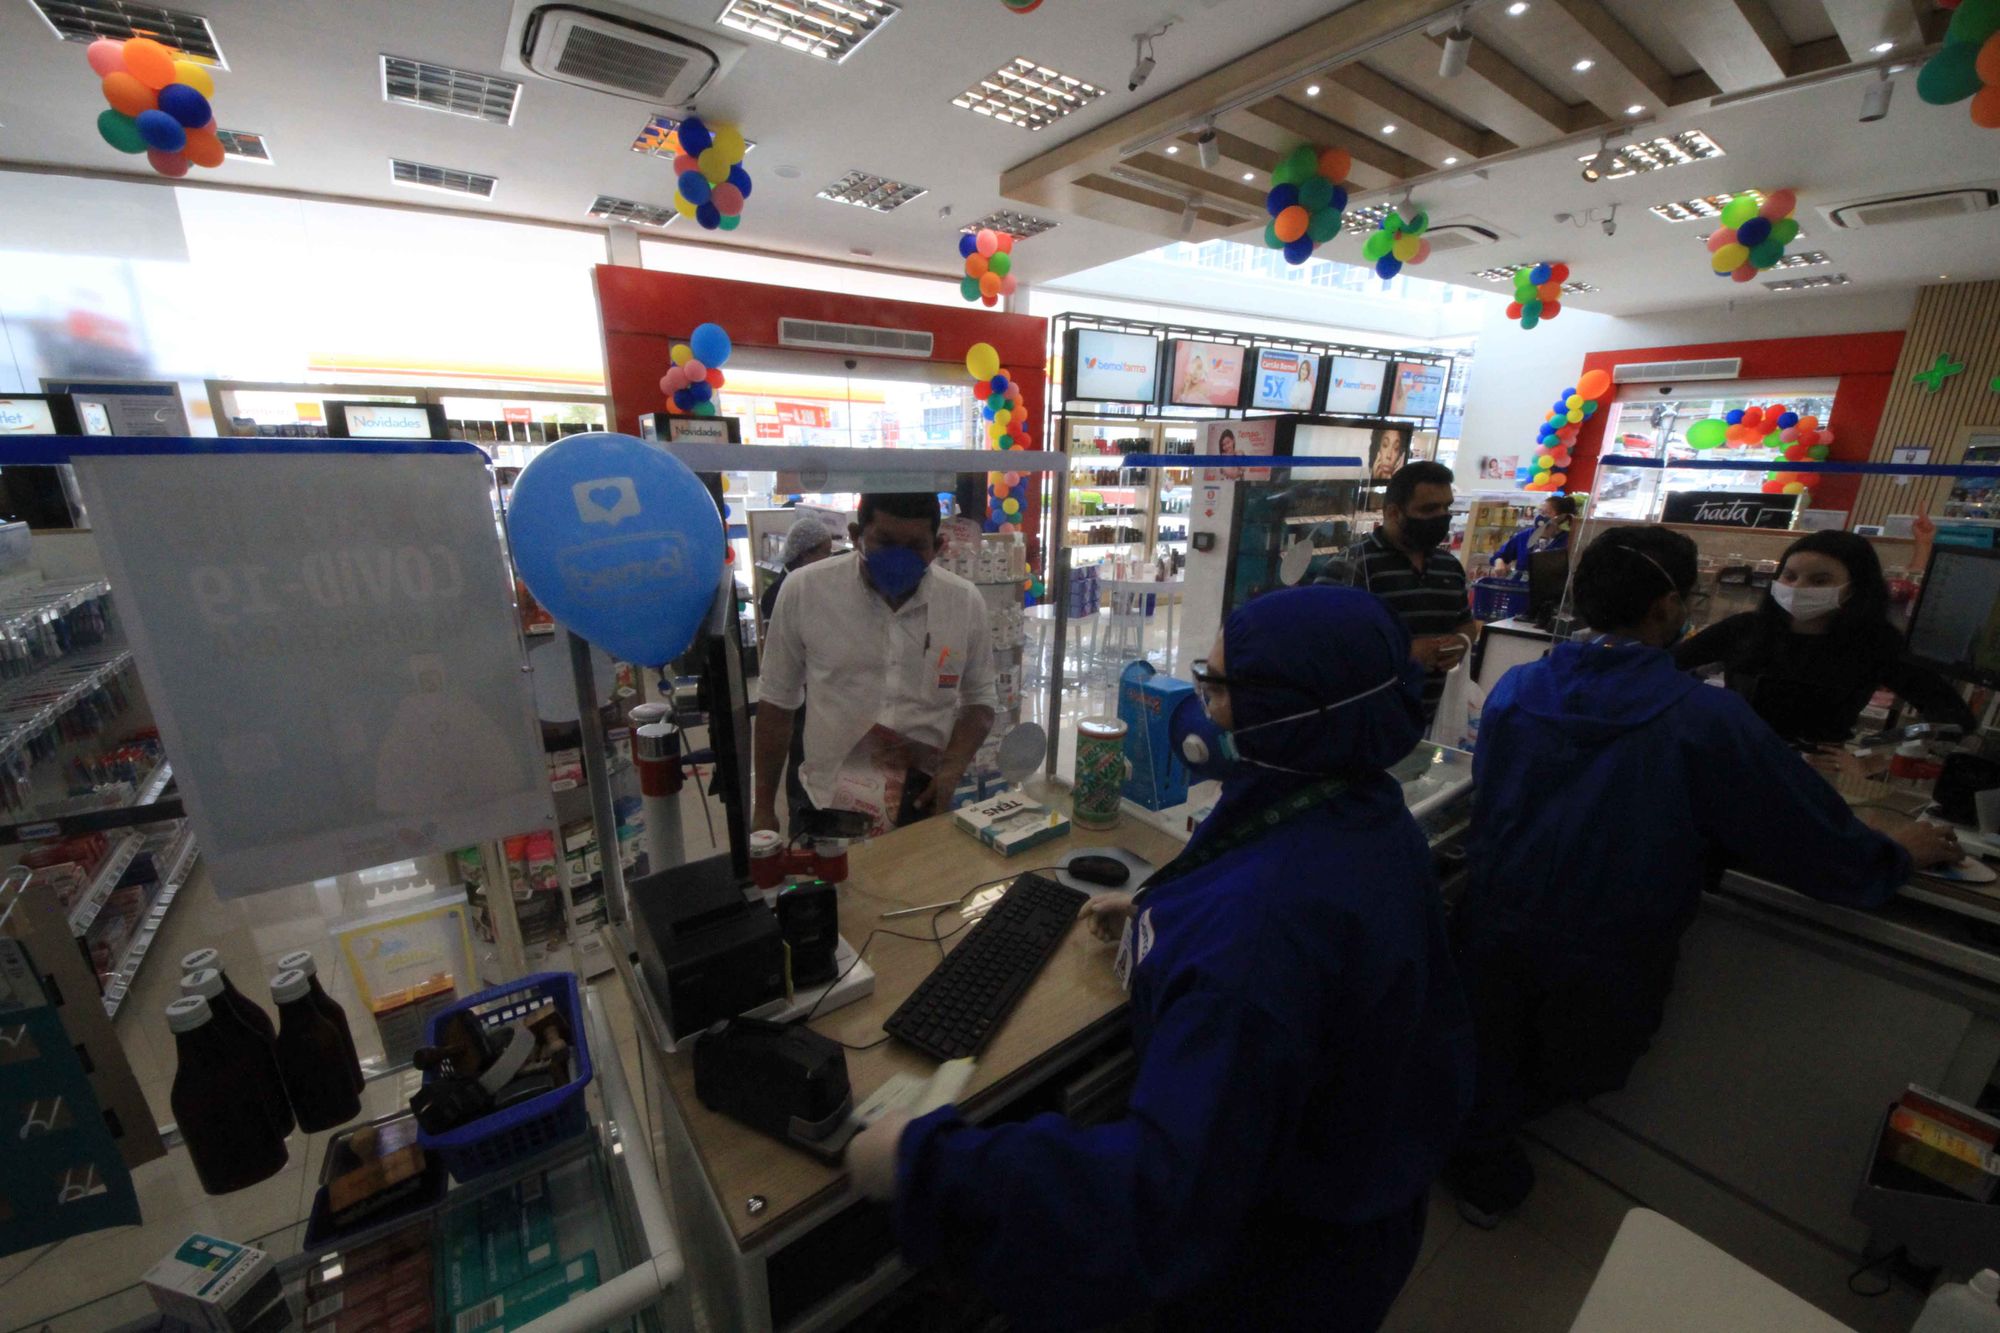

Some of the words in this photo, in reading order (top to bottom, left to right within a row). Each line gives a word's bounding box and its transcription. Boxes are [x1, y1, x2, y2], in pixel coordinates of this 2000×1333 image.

[353, 414, 422, 430] Novidades
[675, 426, 722, 438] Novidades
[1694, 499, 1762, 525] tracta
[982, 799, 1023, 817] TENS
